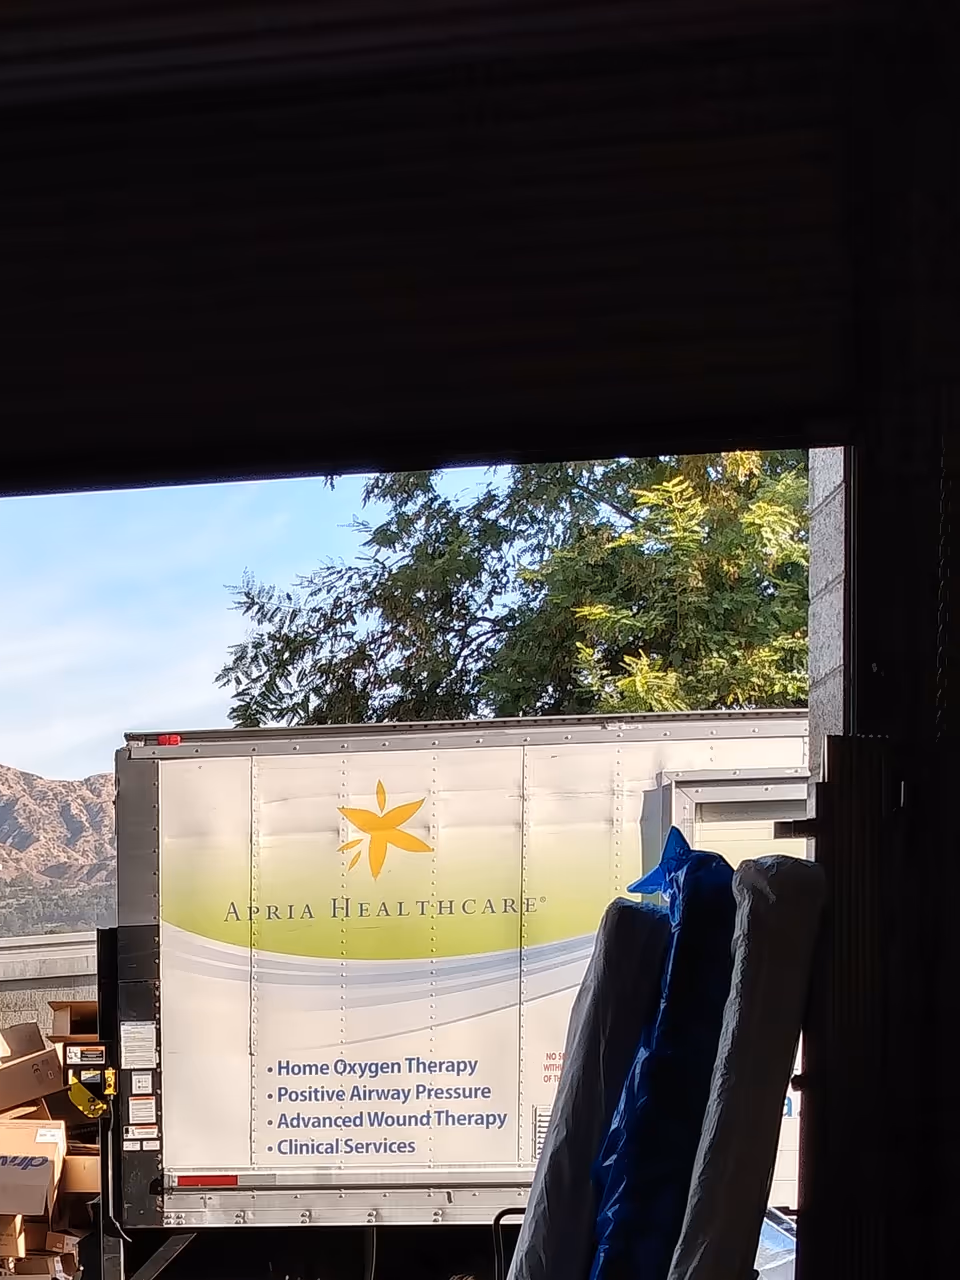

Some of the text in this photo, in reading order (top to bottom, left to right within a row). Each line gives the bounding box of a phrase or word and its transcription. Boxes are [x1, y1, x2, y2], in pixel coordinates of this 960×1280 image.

[224, 901, 315, 922] APRIA
[546, 1052, 556, 1060] NO
[277, 1057, 479, 1079] Home Oxygen Therapy
[543, 1075, 552, 1083] OF
[277, 1084, 492, 1104] Positive Airway Pressure
[277, 1109, 508, 1130] Advanced Wound Therapy
[277, 1137, 416, 1155] Clinical Services
